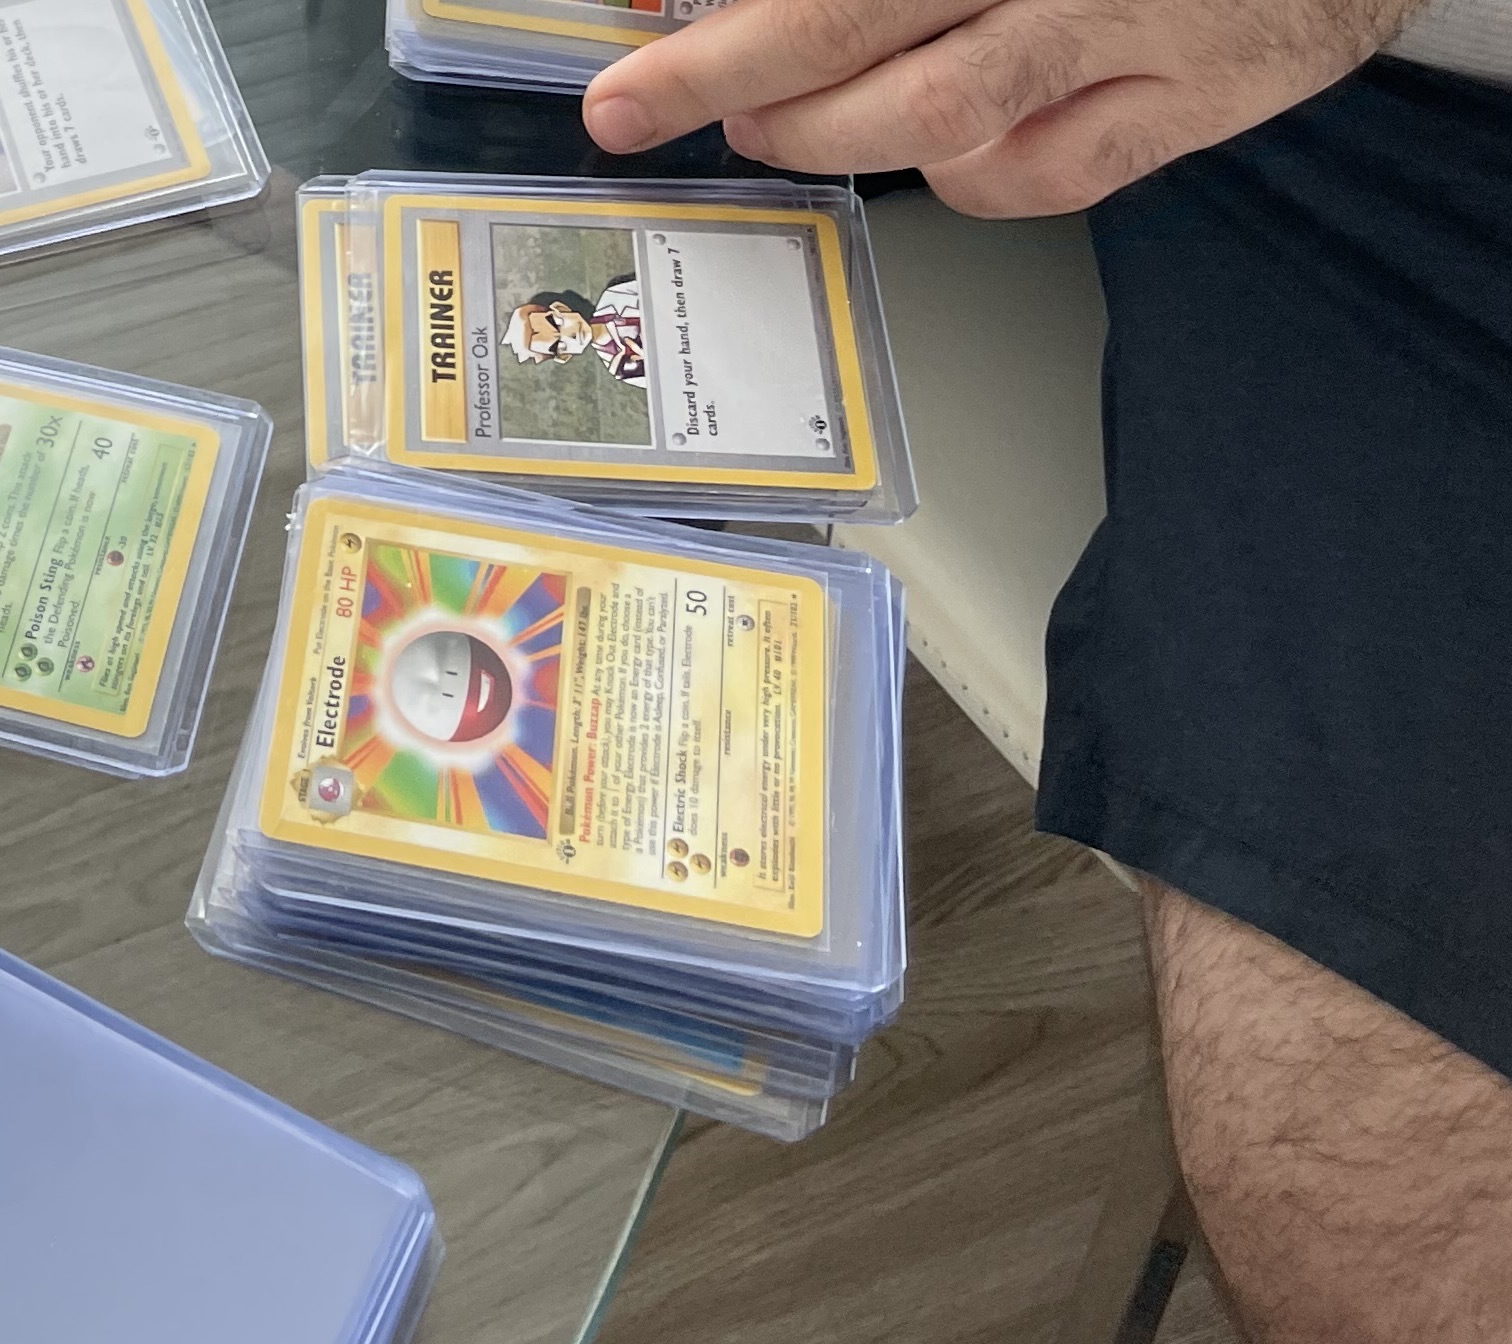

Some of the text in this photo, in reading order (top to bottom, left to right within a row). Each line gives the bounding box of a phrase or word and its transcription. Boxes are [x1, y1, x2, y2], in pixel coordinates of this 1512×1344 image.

[1, 34, 13, 46] or
[3, 46, 18, 62] his
[8, 62, 31, 99] shuffles
[9, 18, 72, 169] hand into his or her deck, then
[22, 98, 50, 147] opponent
[51, 92, 88, 165] draws 7 cards.
[37, 147, 56, 172] Your
[668, 258, 683, 287] draw
[428, 269, 456, 384] TRAINER
[672, 291, 687, 318] then
[348, 272, 377, 384] TRAINER
[675, 321, 692, 354] hand,
[470, 325, 492, 438] Professor Oak
[683, 358, 698, 386] your
[682, 390, 700, 435] Discard
[701, 400, 718, 436] cards.
[88, 434, 115, 460] 40
[22, 593, 49, 641] Poison
[38, 556, 63, 592] Sting
[334, 564, 358, 618] 80 HP
[685, 588, 708, 616] 50
[315, 654, 346, 748] Electrode
[585, 695, 603, 741] Buzzap
[674, 748, 688, 785] Shock
[578, 784, 594, 844] Pokémon
[672, 786, 686, 834] Electric
